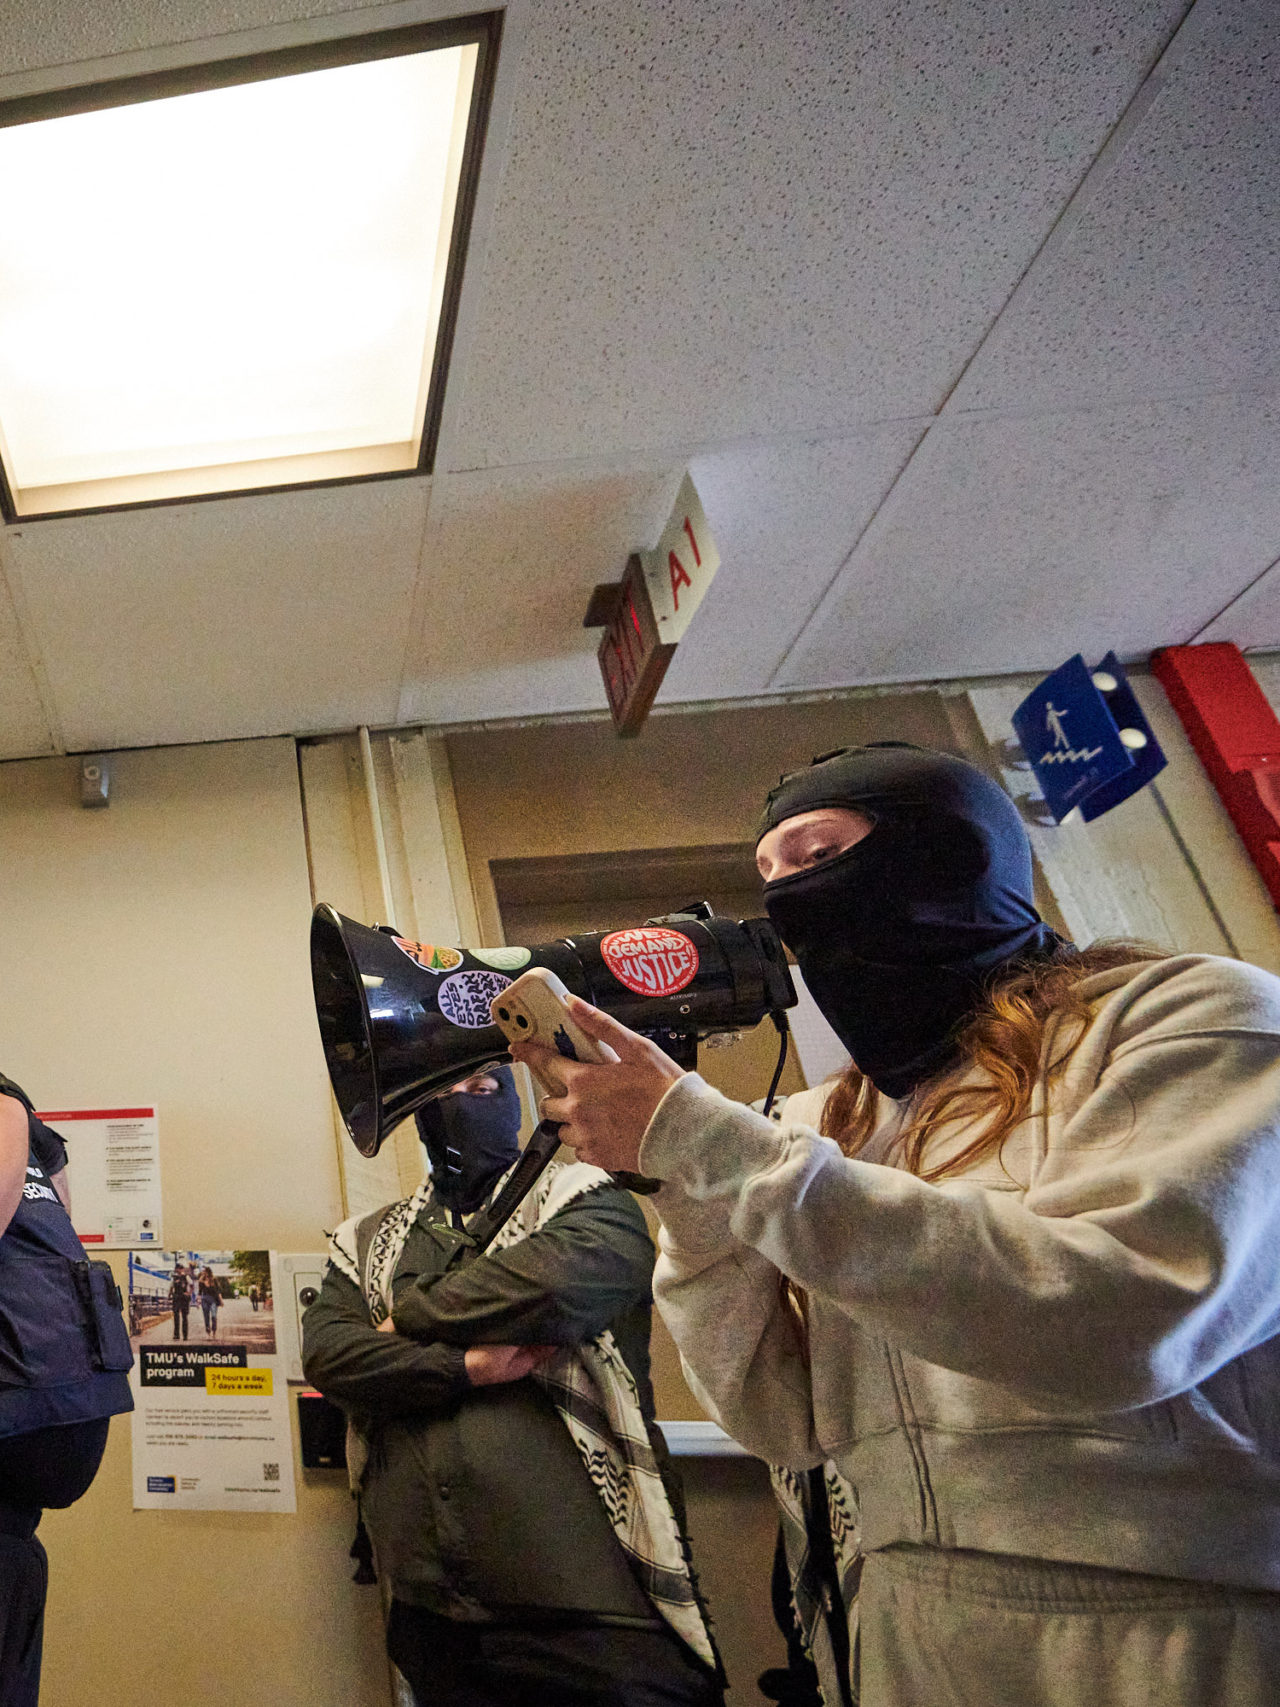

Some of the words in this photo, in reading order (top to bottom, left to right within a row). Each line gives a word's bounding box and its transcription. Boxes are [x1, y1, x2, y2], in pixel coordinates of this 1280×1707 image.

[617, 930, 661, 941] WE
[608, 937, 685, 959] DEMAND
[622, 951, 690, 990] JUSTICE
[440, 989, 456, 1018] ALL
[462, 972, 492, 1026] RAFAH
[462, 999, 475, 1026] ON
[146, 1353, 183, 1364] TMU's
[186, 1353, 239, 1364] WalkSafe
[146, 1368, 195, 1379] program
[222, 1374, 244, 1382] hours
[218, 1382, 235, 1390] days
